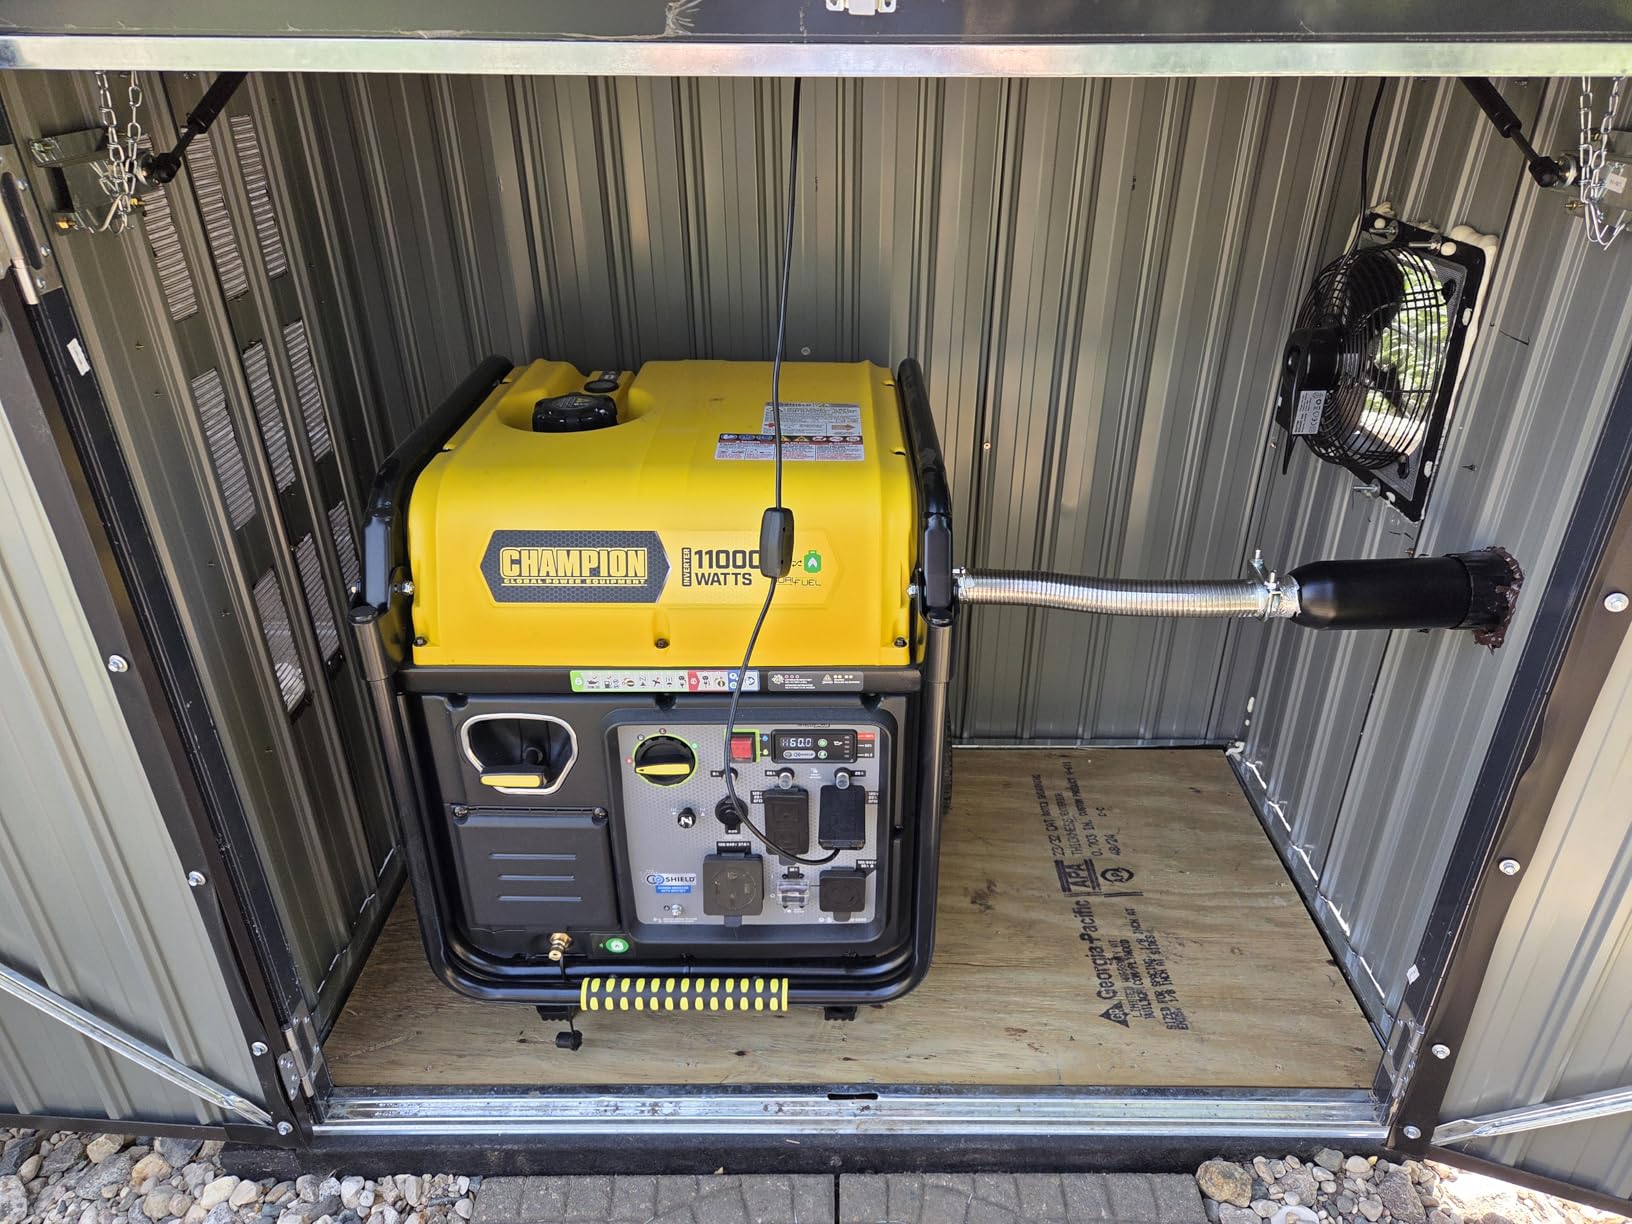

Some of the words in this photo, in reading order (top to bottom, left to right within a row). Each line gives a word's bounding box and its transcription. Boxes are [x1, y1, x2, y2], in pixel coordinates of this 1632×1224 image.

[501, 548, 648, 579] CHAMPION
[695, 550, 760, 569] 11000
[695, 573, 752, 586] WATTS
[1043, 819, 1058, 832] CAT
[1048, 834, 1066, 856] 23/32
[1062, 818, 1083, 855] THICKNESS
[1103, 834, 1121, 856] 48/24
[1065, 864, 1091, 889] APA
[1125, 907, 1137, 916] AT
[1129, 918, 1145, 935] INCH
[1072, 900, 1118, 1000] Georgia-Pacific
[1144, 934, 1162, 955] SIDES
[1154, 990, 1169, 1004] FOR
[1160, 1006, 1178, 1031] SIZED
